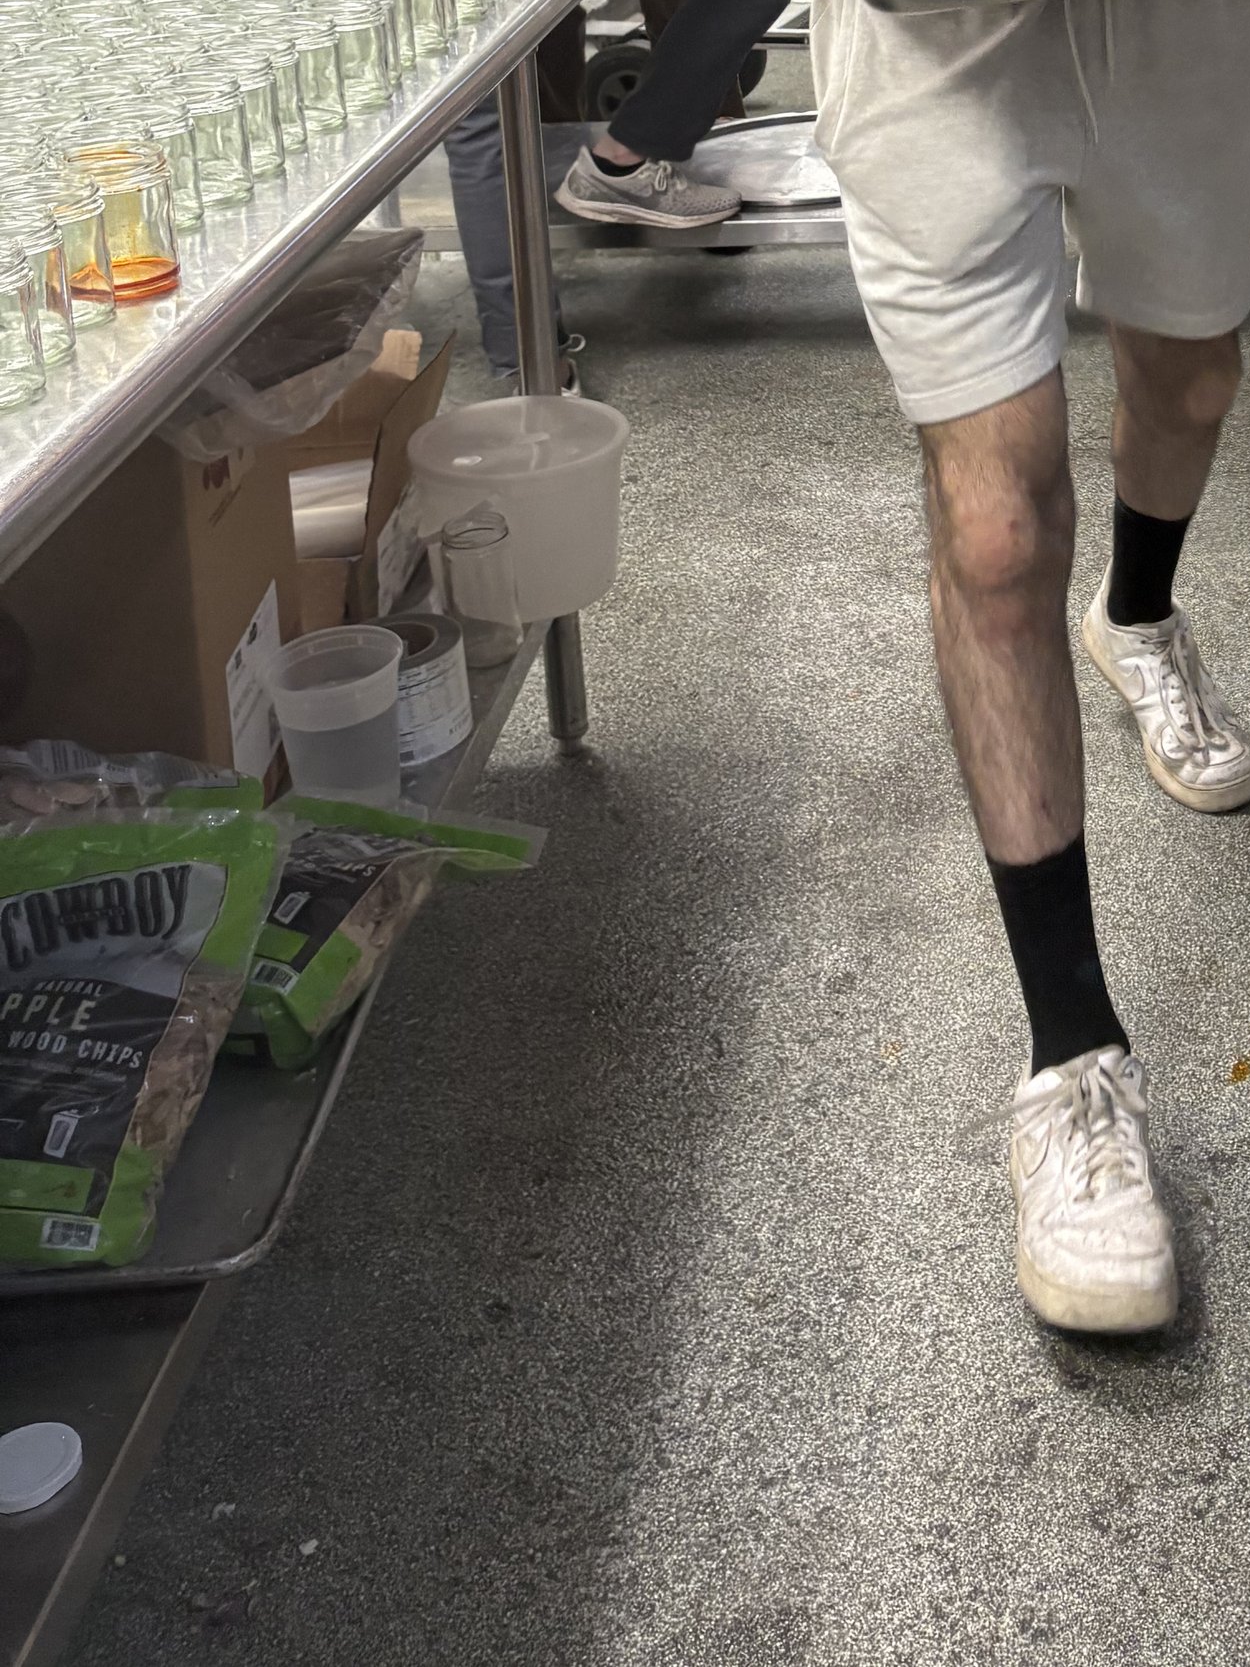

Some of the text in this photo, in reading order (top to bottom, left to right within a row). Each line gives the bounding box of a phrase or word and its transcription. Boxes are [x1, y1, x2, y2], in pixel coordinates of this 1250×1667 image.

[1, 865, 192, 968] COWBOY
[8, 1031, 143, 1068] WOOD CHIPS
